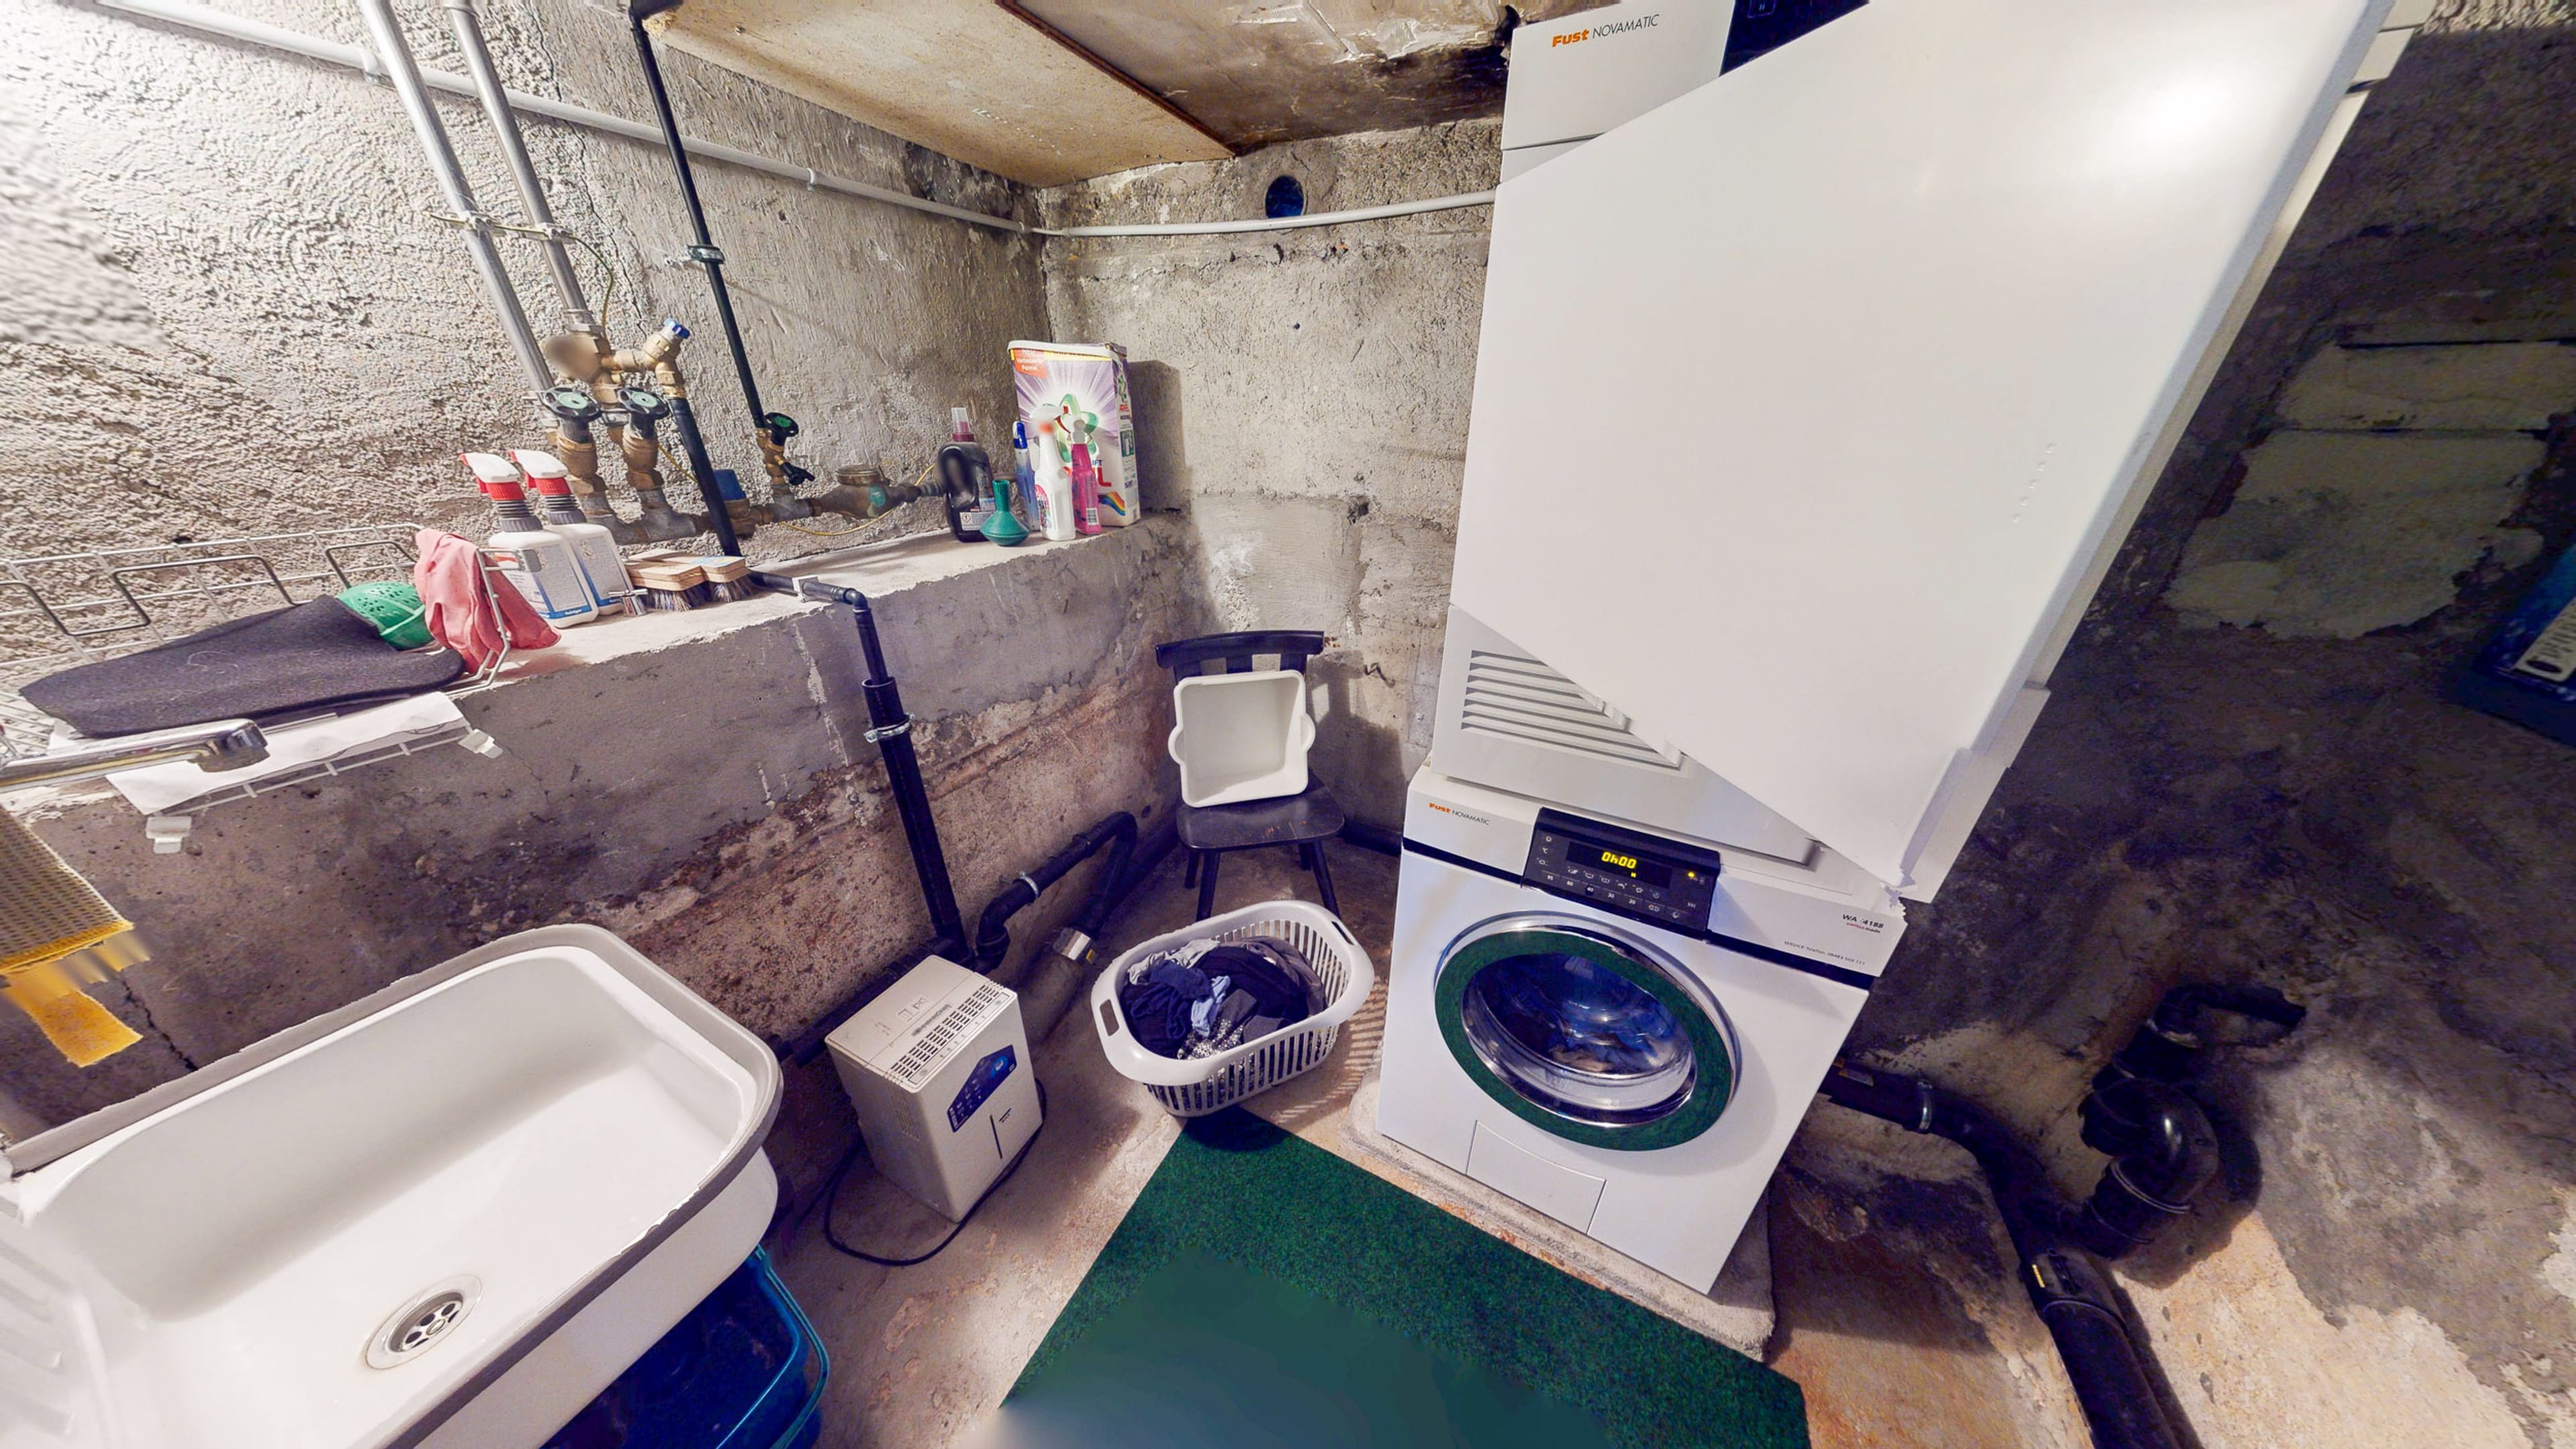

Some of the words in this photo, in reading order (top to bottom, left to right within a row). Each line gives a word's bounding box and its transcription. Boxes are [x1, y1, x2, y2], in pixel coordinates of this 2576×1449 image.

[1552, 28, 1589, 48] Fust
[1592, 13, 1660, 39] NOVAMATIC
[1428, 802, 1451, 814] Fust
[1452, 809, 1491, 826] NOVAMATIC
[1601, 851, 1638, 869] 0h00
[1843, 913, 1858, 922] WA
